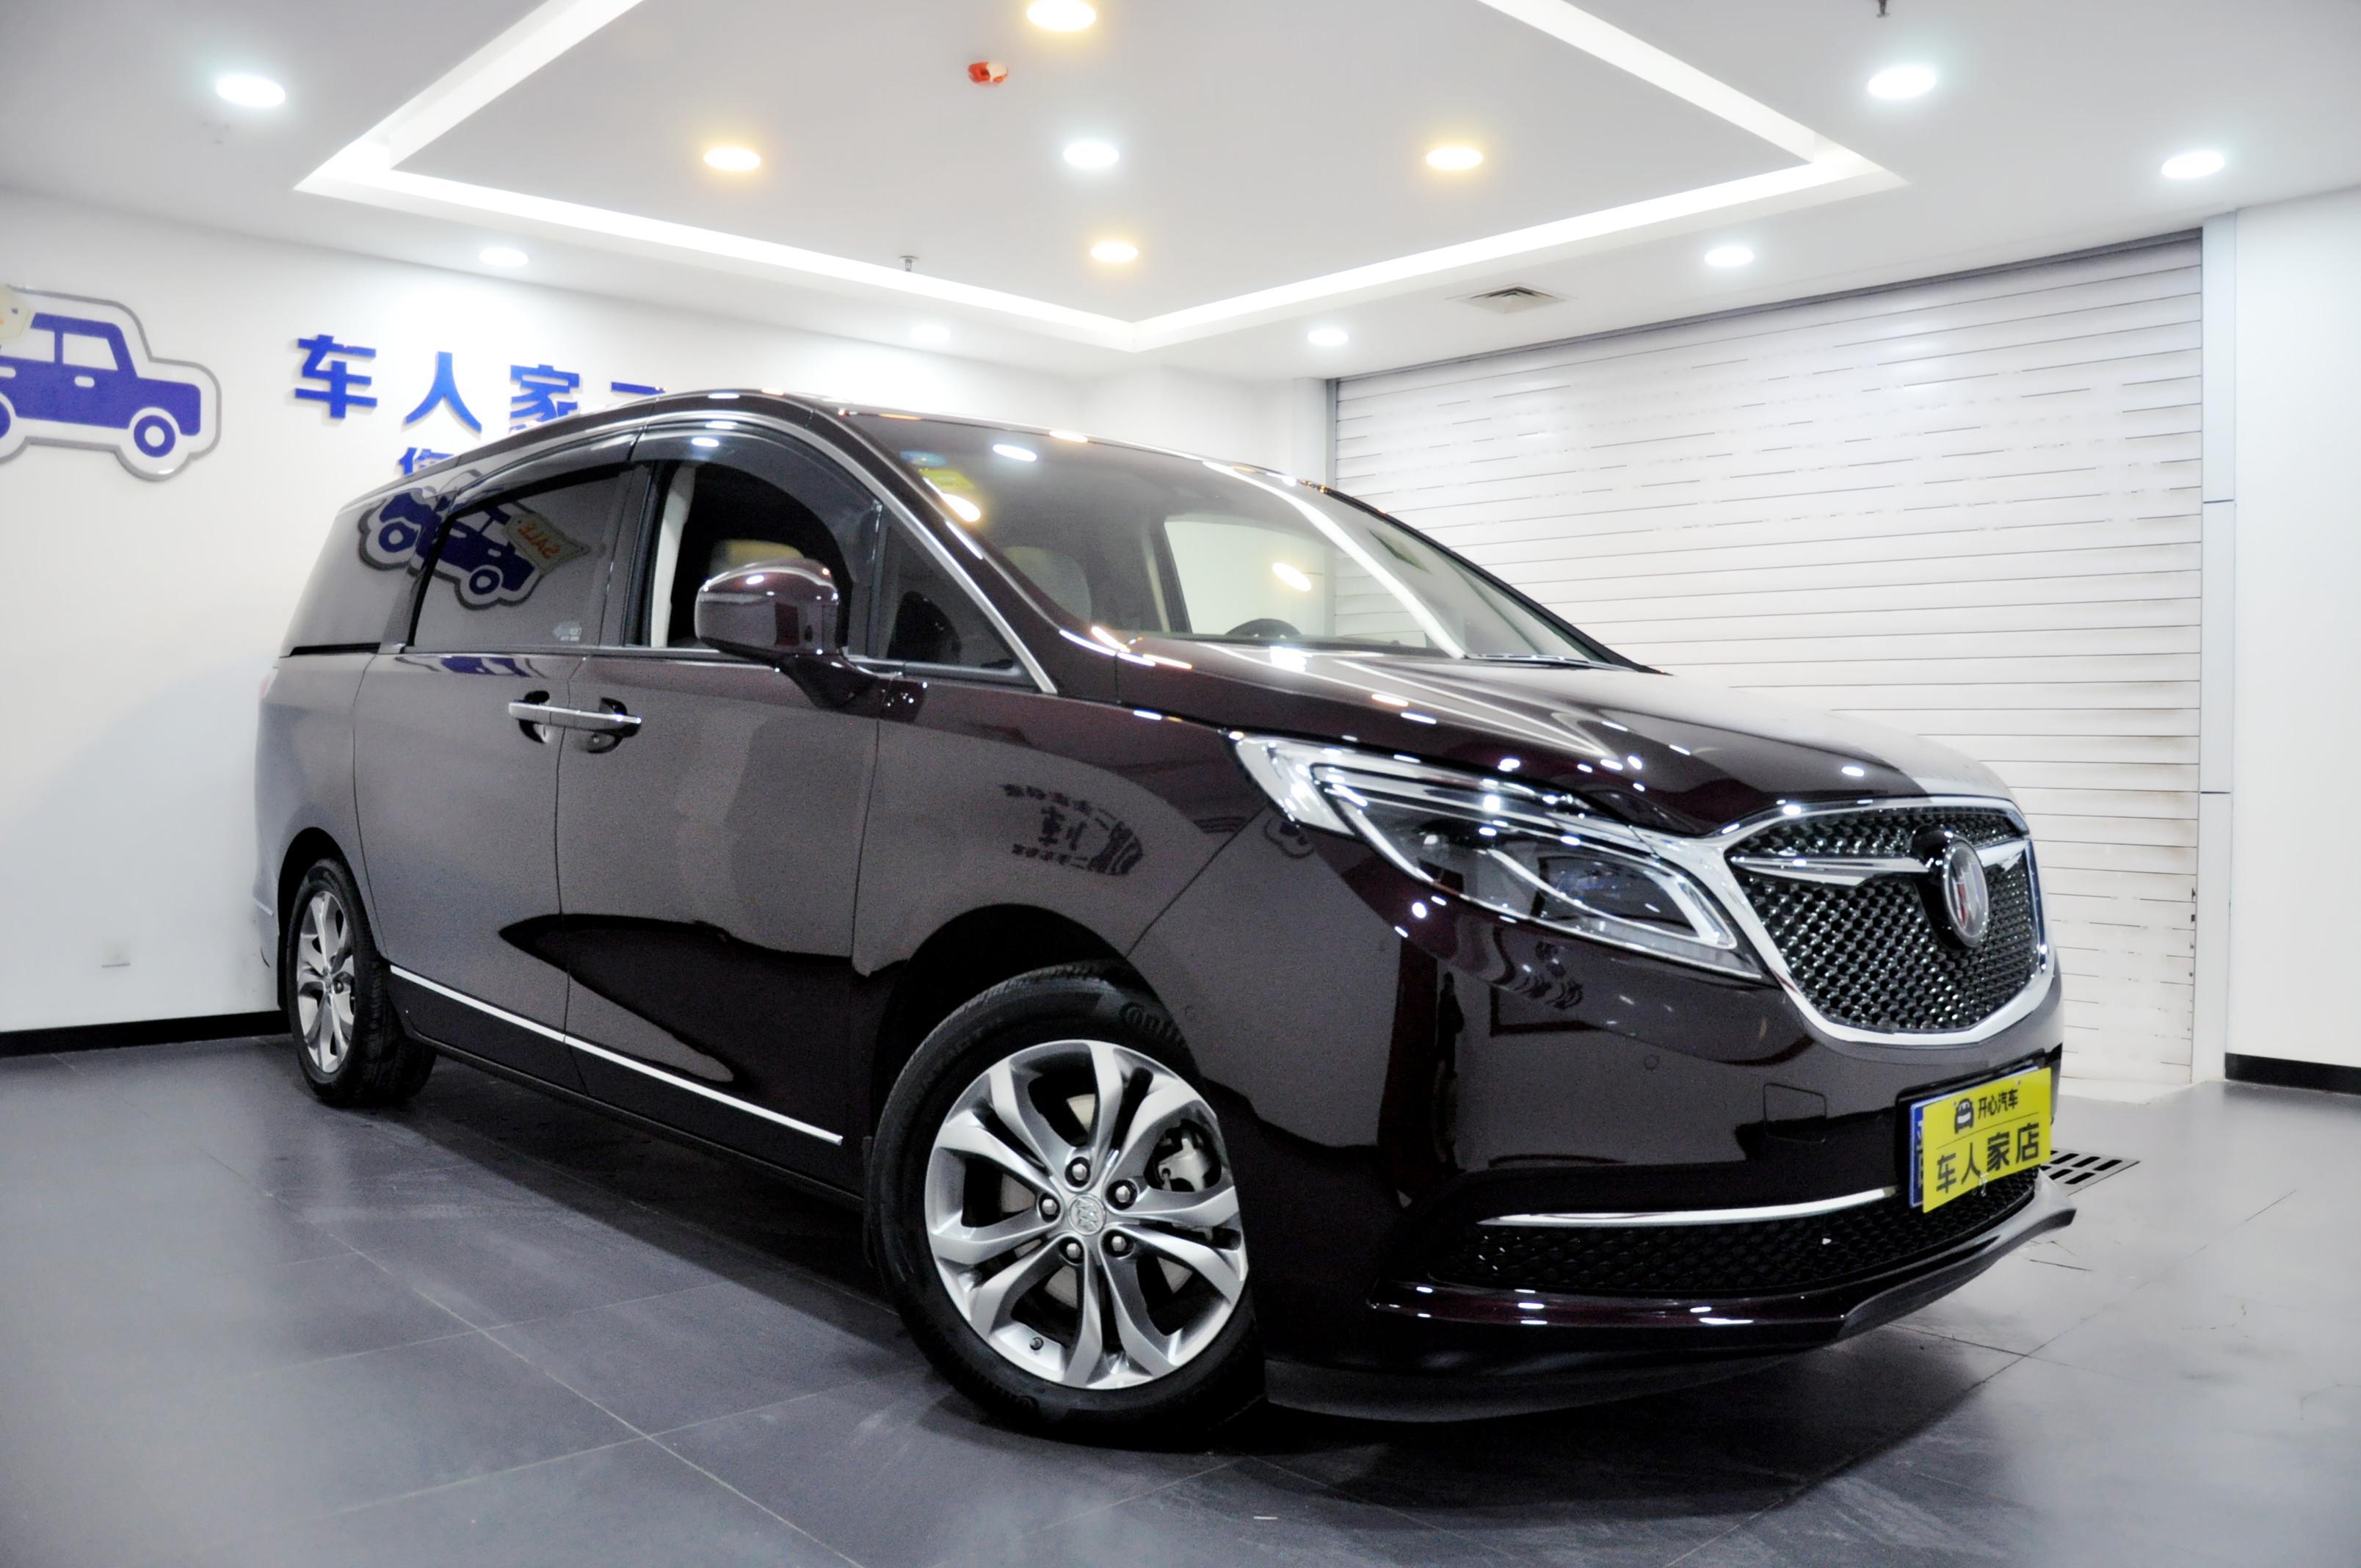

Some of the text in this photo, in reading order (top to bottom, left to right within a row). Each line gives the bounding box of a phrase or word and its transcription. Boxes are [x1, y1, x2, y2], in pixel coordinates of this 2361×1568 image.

[295, 334, 665, 436] 车人家
[1978, 1089, 2018, 1119] 开心汽车
[1936, 1122, 2039, 1194] 车人家店
